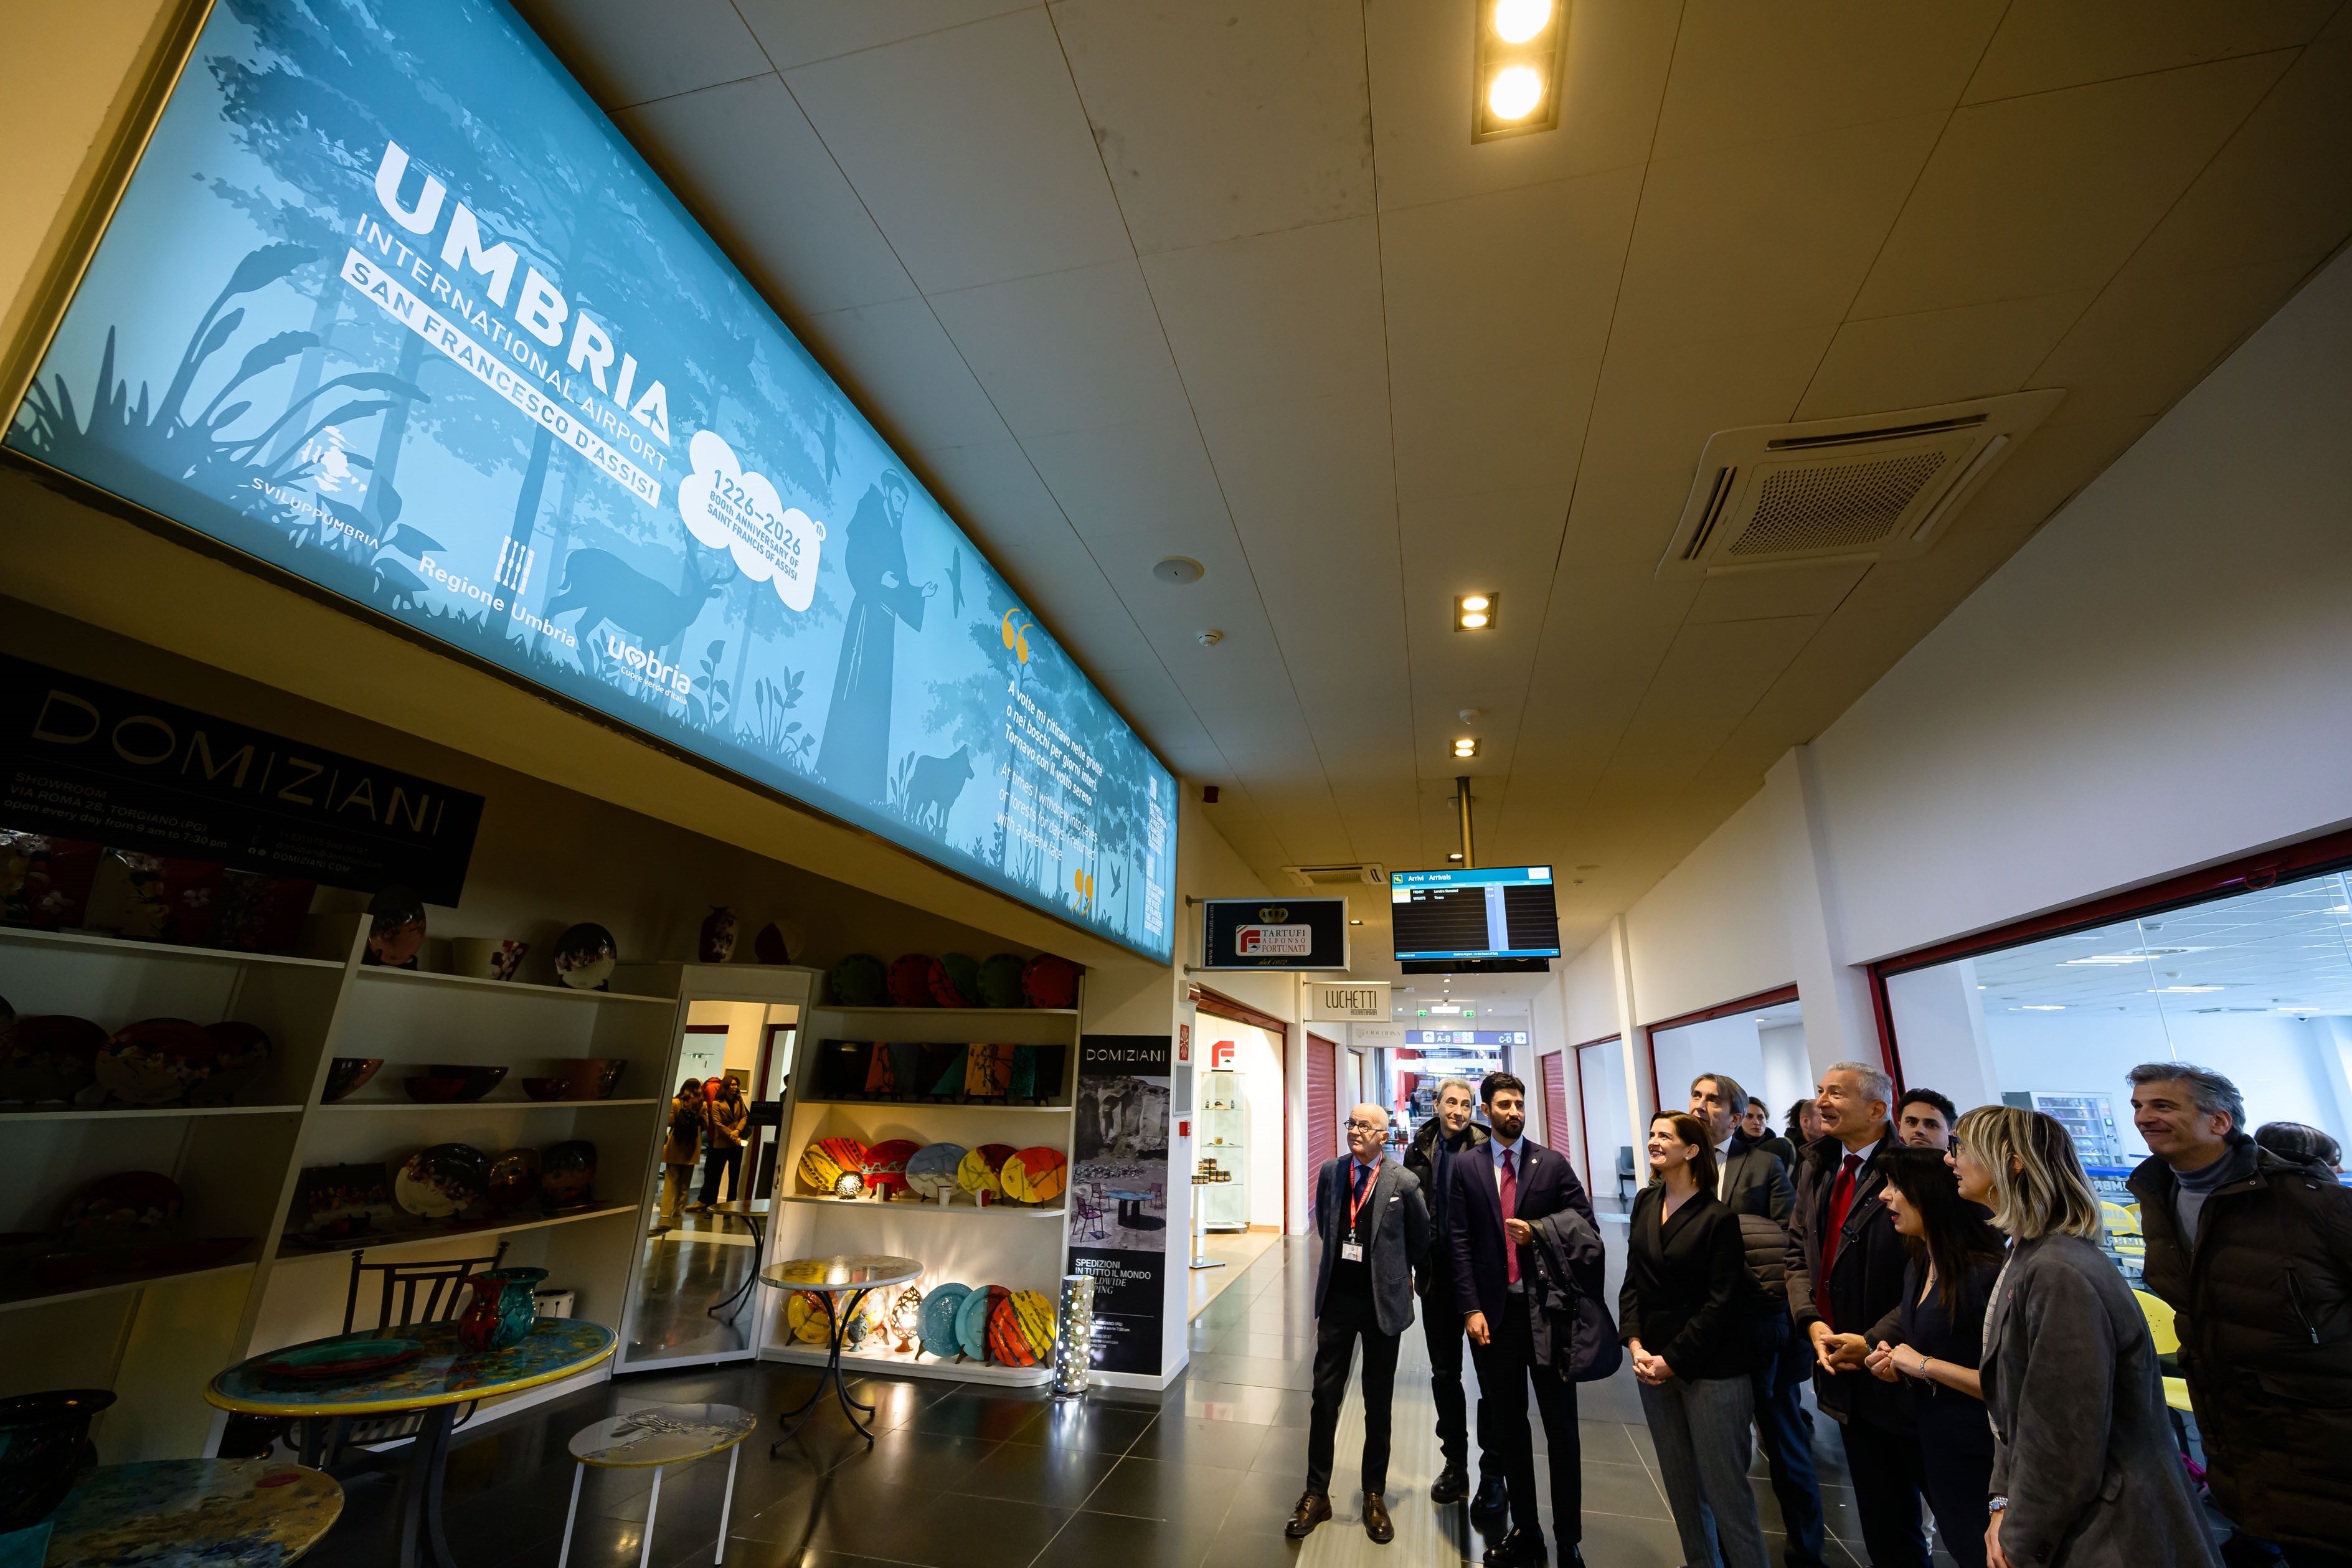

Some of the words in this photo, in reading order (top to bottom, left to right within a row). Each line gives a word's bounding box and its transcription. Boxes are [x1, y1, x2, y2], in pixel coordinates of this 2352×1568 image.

[374, 140, 671, 446] UMBRIA
[356, 213, 574, 404] INTERNATIONAL
[580, 397, 668, 472] AIRPORT
[351, 262, 413, 314] SAN
[423, 308, 569, 437] FRANCESCO
[576, 433, 658, 499] D'ASSISI
[252, 478, 379, 549] SVILUPPUMBRIA
[710, 491, 734, 516] 800th
[735, 512, 788, 559] ANNIVERSARY
[790, 557, 799, 568] OF
[707, 503, 732, 528] SAINT
[732, 524, 764, 554] FRANCIS
[765, 550, 775, 562] OF
[775, 558, 797, 581] ASSISI
[418, 555, 504, 612] Regione
[511, 602, 576, 649] Umbria
[620, 666, 643, 682] Cuore
[644, 679, 664, 694] verde
[664, 689, 687, 705] d'Italia
[1006, 705, 1012, 717] o
[1013, 711, 1027, 729] nei
[1027, 719, 1051, 750] boschi
[1051, 743, 1062, 760] per
[1063, 754, 1082, 777] giorni
[1082, 768, 1097, 792] interi.
[1008, 681, 1014, 696] A
[1017, 689, 1036, 714] volte
[1036, 708, 1046, 725] mi
[1047, 718, 1070, 747] ritiravo
[1071, 740, 1085, 761] nelle
[1086, 755, 1102, 777] grotte
[14, 772, 108, 800] SHOWROOM
[31, 689, 444, 836] DOMIZIANI
[1006, 723, 1036, 760] Tornavo
[1037, 755, 1049, 772] con
[1050, 762, 1056, 777] il
[1056, 769, 1072, 790] volto
[1072, 783, 1092, 806] sereno
[3, 798, 39, 813] open
[42, 806, 78, 821] every
[80, 812, 102, 827] day
[105, 818, 133, 831] from
[136, 823, 145, 833] 9
[146, 827, 166, 837] am
[168, 828, 179, 839] to
[183, 833, 208, 844] 7:30
[209, 839, 229, 849] pm
[10, 784, 34, 799] VIA
[37, 790, 81, 808] ROMA
[109, 805, 178, 827] TORGIANO
[181, 819, 207, 833] (PG)
[999, 788, 1009, 803] or
[1010, 793, 1036, 822] forests
[1037, 811, 1048, 829] for
[1049, 822, 1065, 842] days.
[1067, 831, 1070, 844] I
[1071, 836, 1096, 861] returned
[1001, 762, 1011, 780] At
[1012, 771, 1033, 796] times
[1035, 786, 1038, 800] I
[1039, 791, 1069, 821] withdrew
[1070, 815, 1082, 831] into
[1082, 824, 1098, 843] caves
[997, 811, 1014, 833] with
[1016, 824, 1021, 836] a
[1023, 829, 1047, 852] serene
[1049, 841, 1062, 861] face
[272, 851, 351, 873] DOMIZIANI.COM
[1262, 929, 1306, 937] TARTUFI
[1262, 945, 1306, 953] FORTUNATI
[1326, 990, 1377, 1008] LUCHETTI
[1087, 1049, 1165, 1062] DOMIZIANI
[1499, 1036, 1512, 1044] C-D
[1075, 1259, 1120, 1269] SPEDIZIONI
[1084, 1268, 1110, 1277] TUTTO
[1120, 1270, 1151, 1280] MONDO
[1094, 1277, 1126, 1287] LDWIDE
